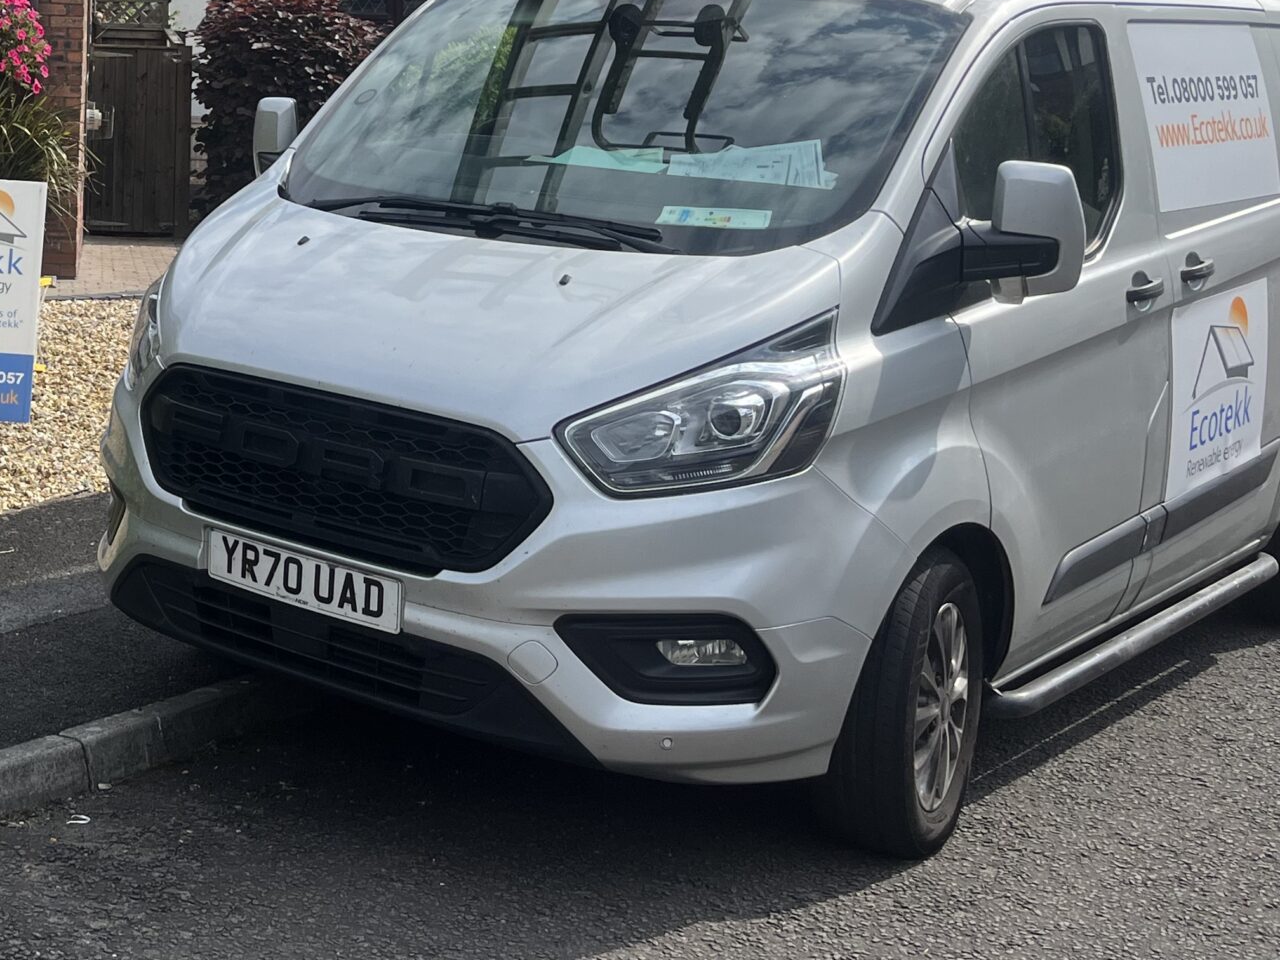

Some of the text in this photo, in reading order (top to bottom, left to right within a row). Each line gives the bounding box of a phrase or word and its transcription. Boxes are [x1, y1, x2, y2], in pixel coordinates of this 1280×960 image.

[1216, 75, 1238, 101] 599
[1240, 74, 1258, 99] 057
[1156, 107, 1269, 148] www.Ecotekk.co.uk
[7, 309, 18, 318] of
[1189, 385, 1252, 451] Ecotekk
[1187, 440, 1242, 478] Renewable energy
[222, 535, 384, 618] YR70 UAD
